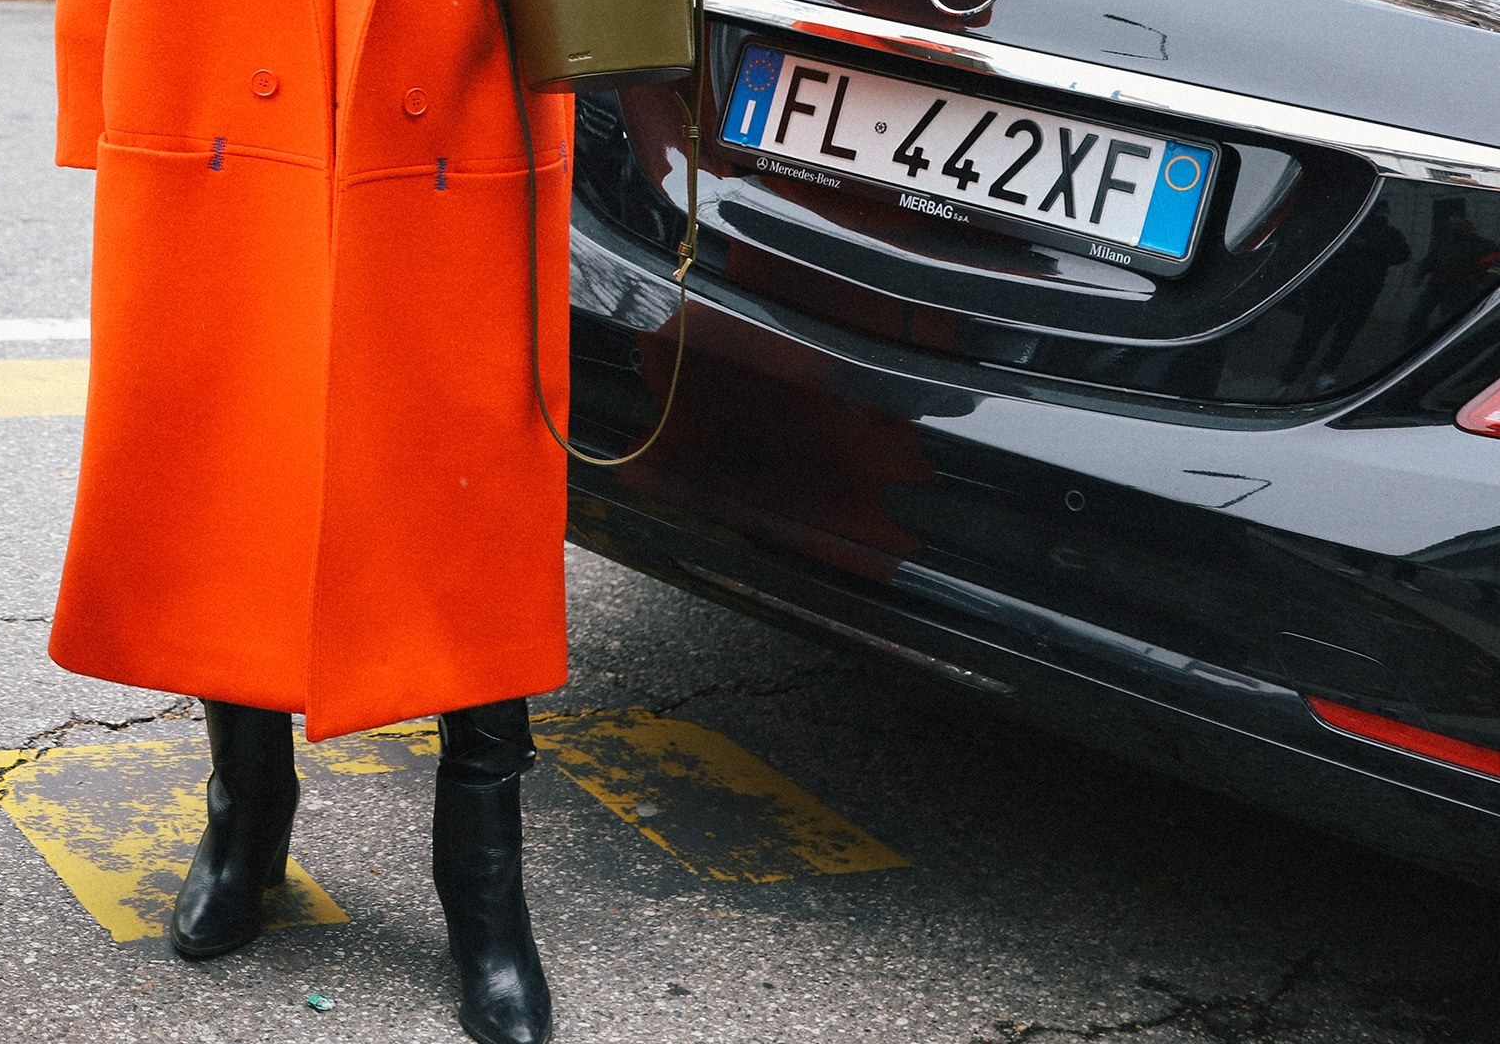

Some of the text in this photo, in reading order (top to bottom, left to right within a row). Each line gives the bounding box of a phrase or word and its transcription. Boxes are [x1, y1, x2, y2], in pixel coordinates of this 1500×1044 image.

[775, 65, 1152, 224] FL 442XF
[769, 161, 841, 188] Mercedes-Benz
[899, 193, 954, 219] MERBAG
[1089, 244, 1132, 265] Milano
